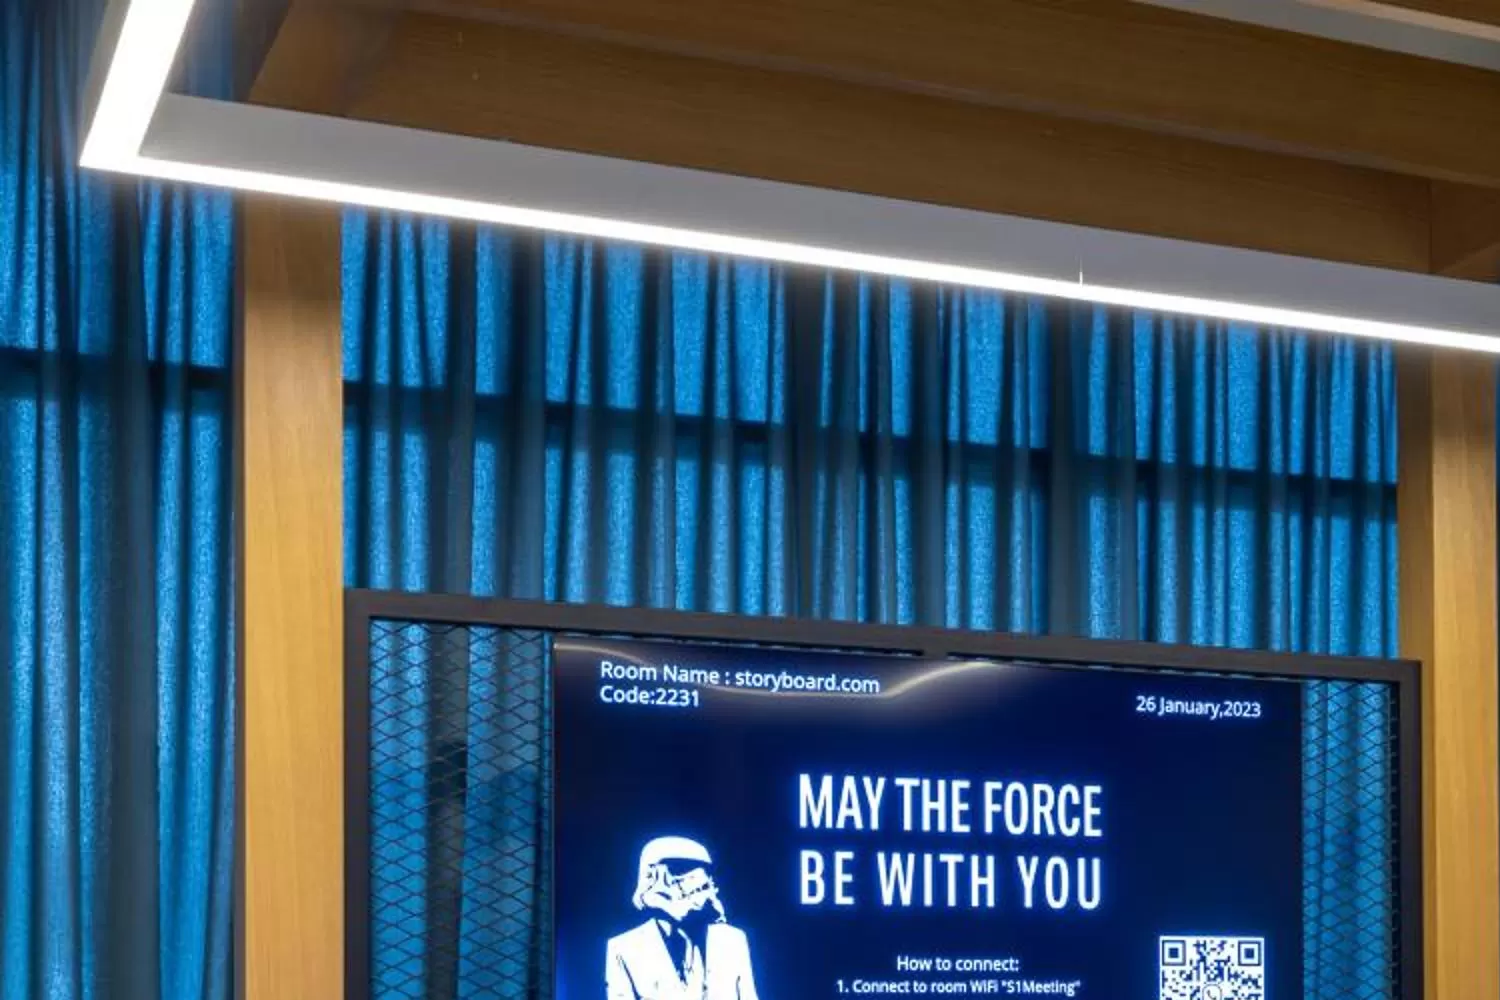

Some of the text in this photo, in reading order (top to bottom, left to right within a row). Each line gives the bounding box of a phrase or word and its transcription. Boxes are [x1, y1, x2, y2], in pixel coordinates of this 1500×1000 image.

[600, 661, 657, 681] Room
[663, 665, 720, 684] Name
[735, 670, 880, 693] storyboard.com
[599, 685, 700, 708] Code:2231
[1136, 695, 1261, 721] 26 January,2023
[799, 774, 1102, 837] MAY THE FORCE
[799, 849, 1101, 910] BE WITH YOU
[897, 955, 1019, 972] How to connect:
[837, 980, 849, 993] 1.
[852, 980, 911, 993] Connect
[912, 980, 928, 993] to
[930, 981, 967, 993] room
